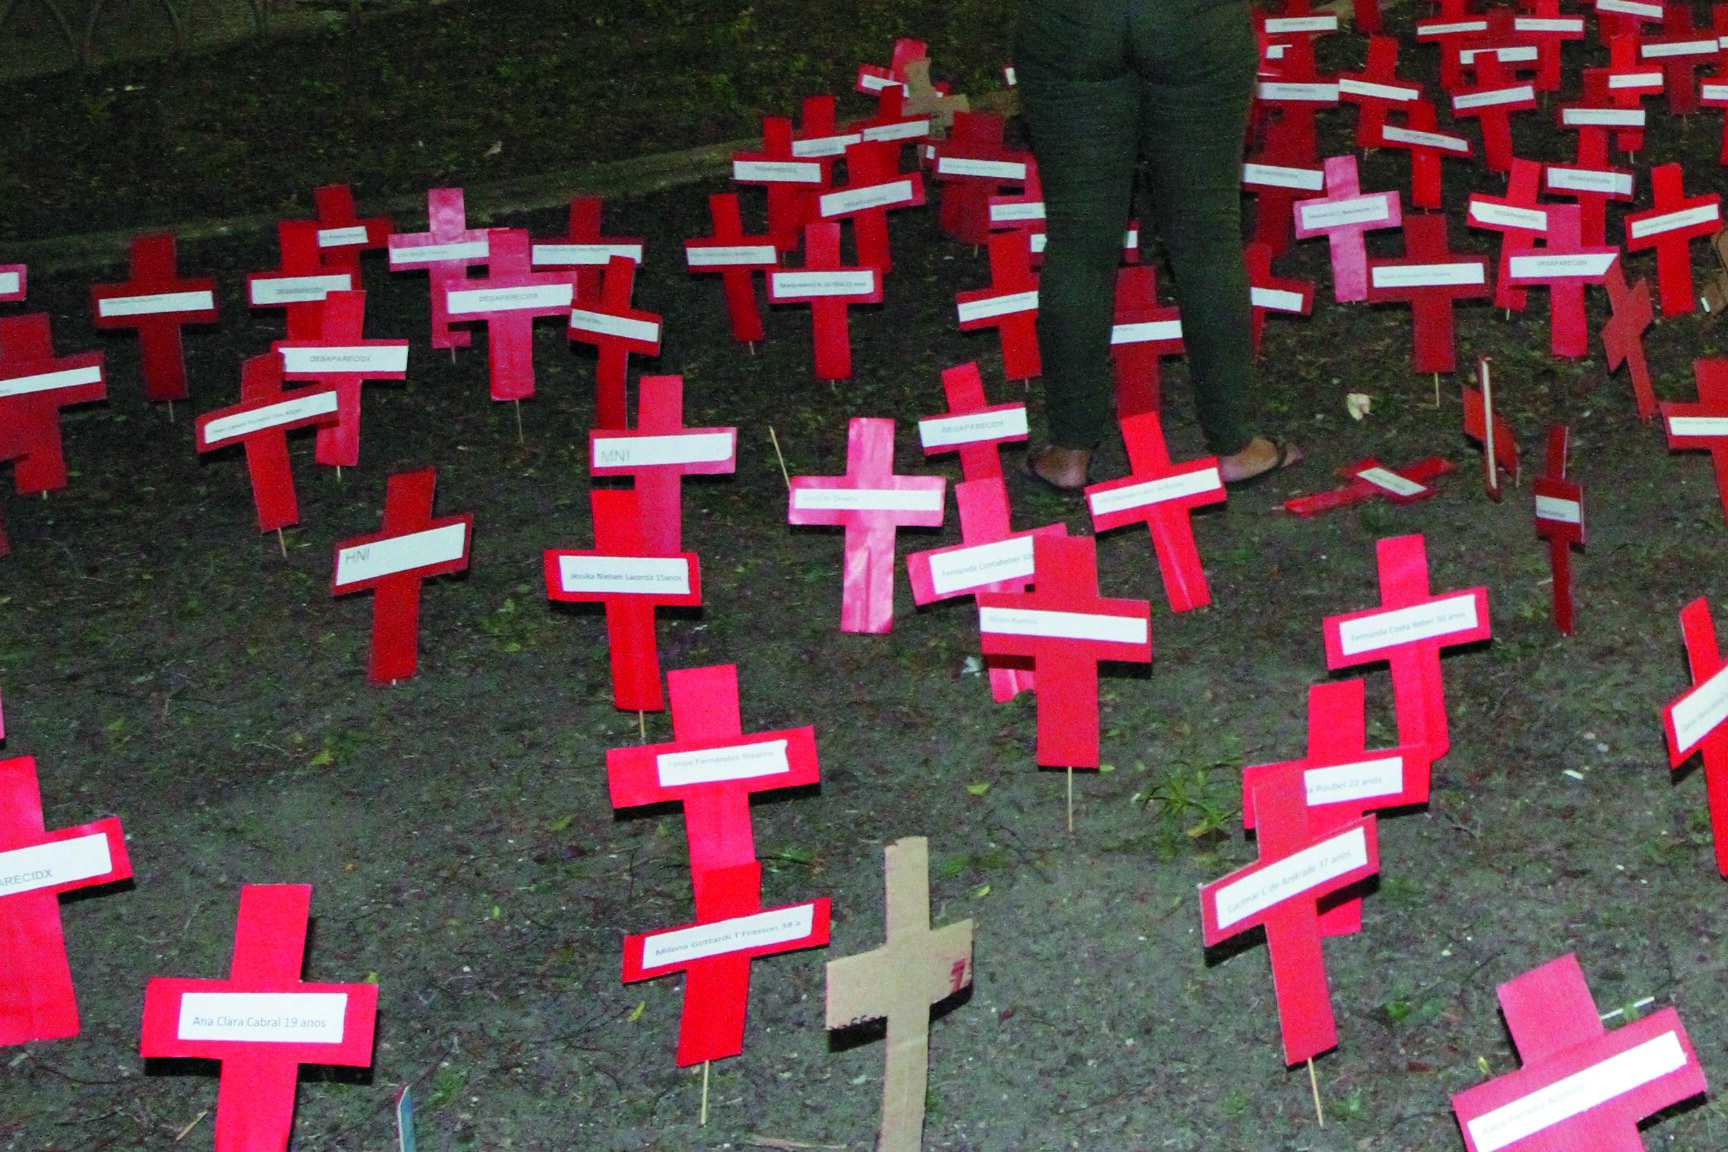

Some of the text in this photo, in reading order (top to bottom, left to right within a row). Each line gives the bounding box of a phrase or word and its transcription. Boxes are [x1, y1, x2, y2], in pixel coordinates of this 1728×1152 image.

[600, 448, 630, 463] MNI
[344, 546, 370, 564] HNI
[192, 1014, 326, 1029] Ana Clara Cabral 19 anos
